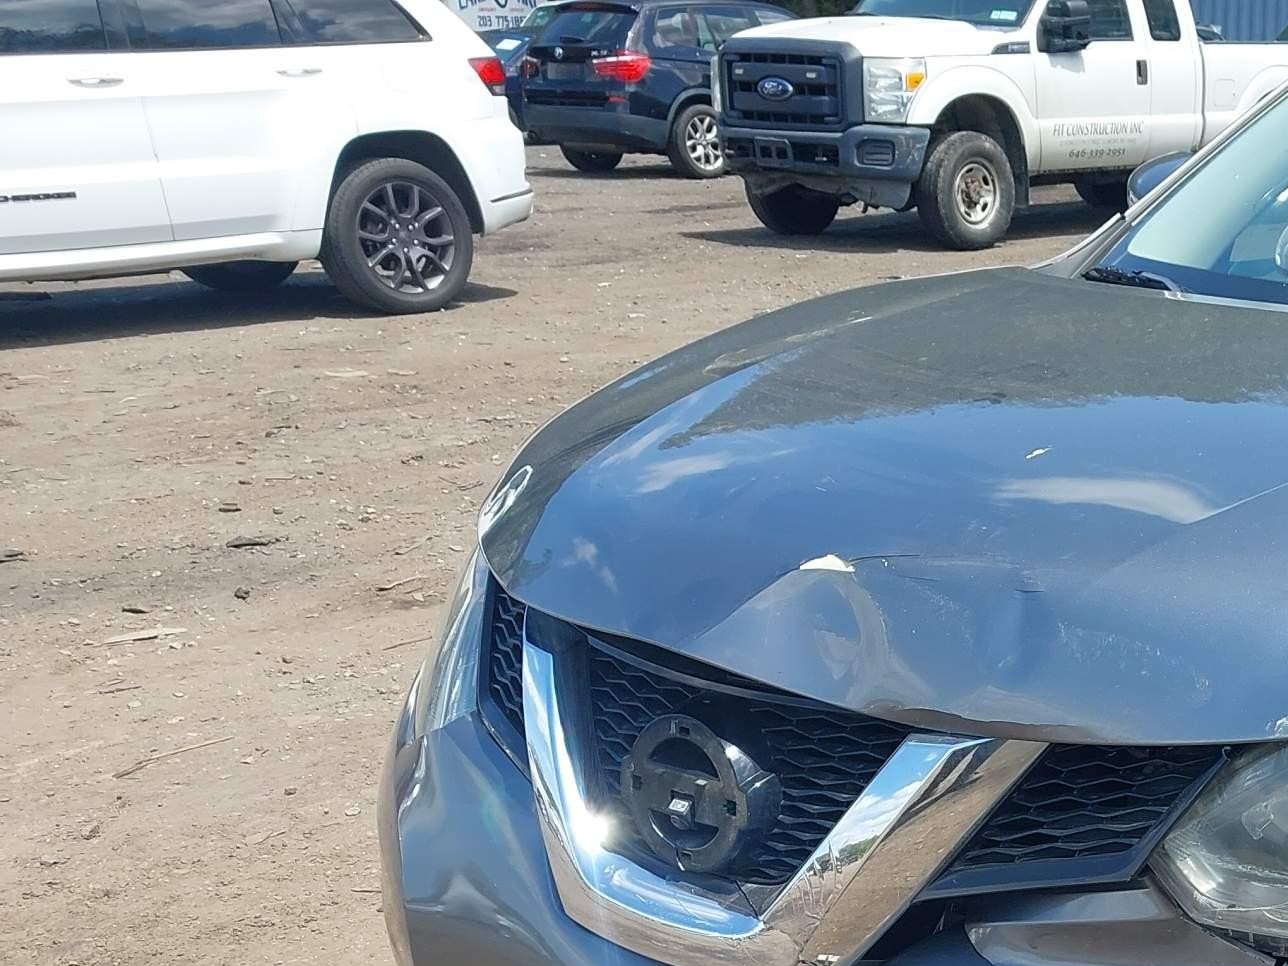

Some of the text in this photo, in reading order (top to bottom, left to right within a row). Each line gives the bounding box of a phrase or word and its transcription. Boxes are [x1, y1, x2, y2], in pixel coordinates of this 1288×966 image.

[477, 15, 492, 28] 203
[1066, 121, 1129, 137] CONSTRUCTION
[1129, 120, 1144, 134] INC
